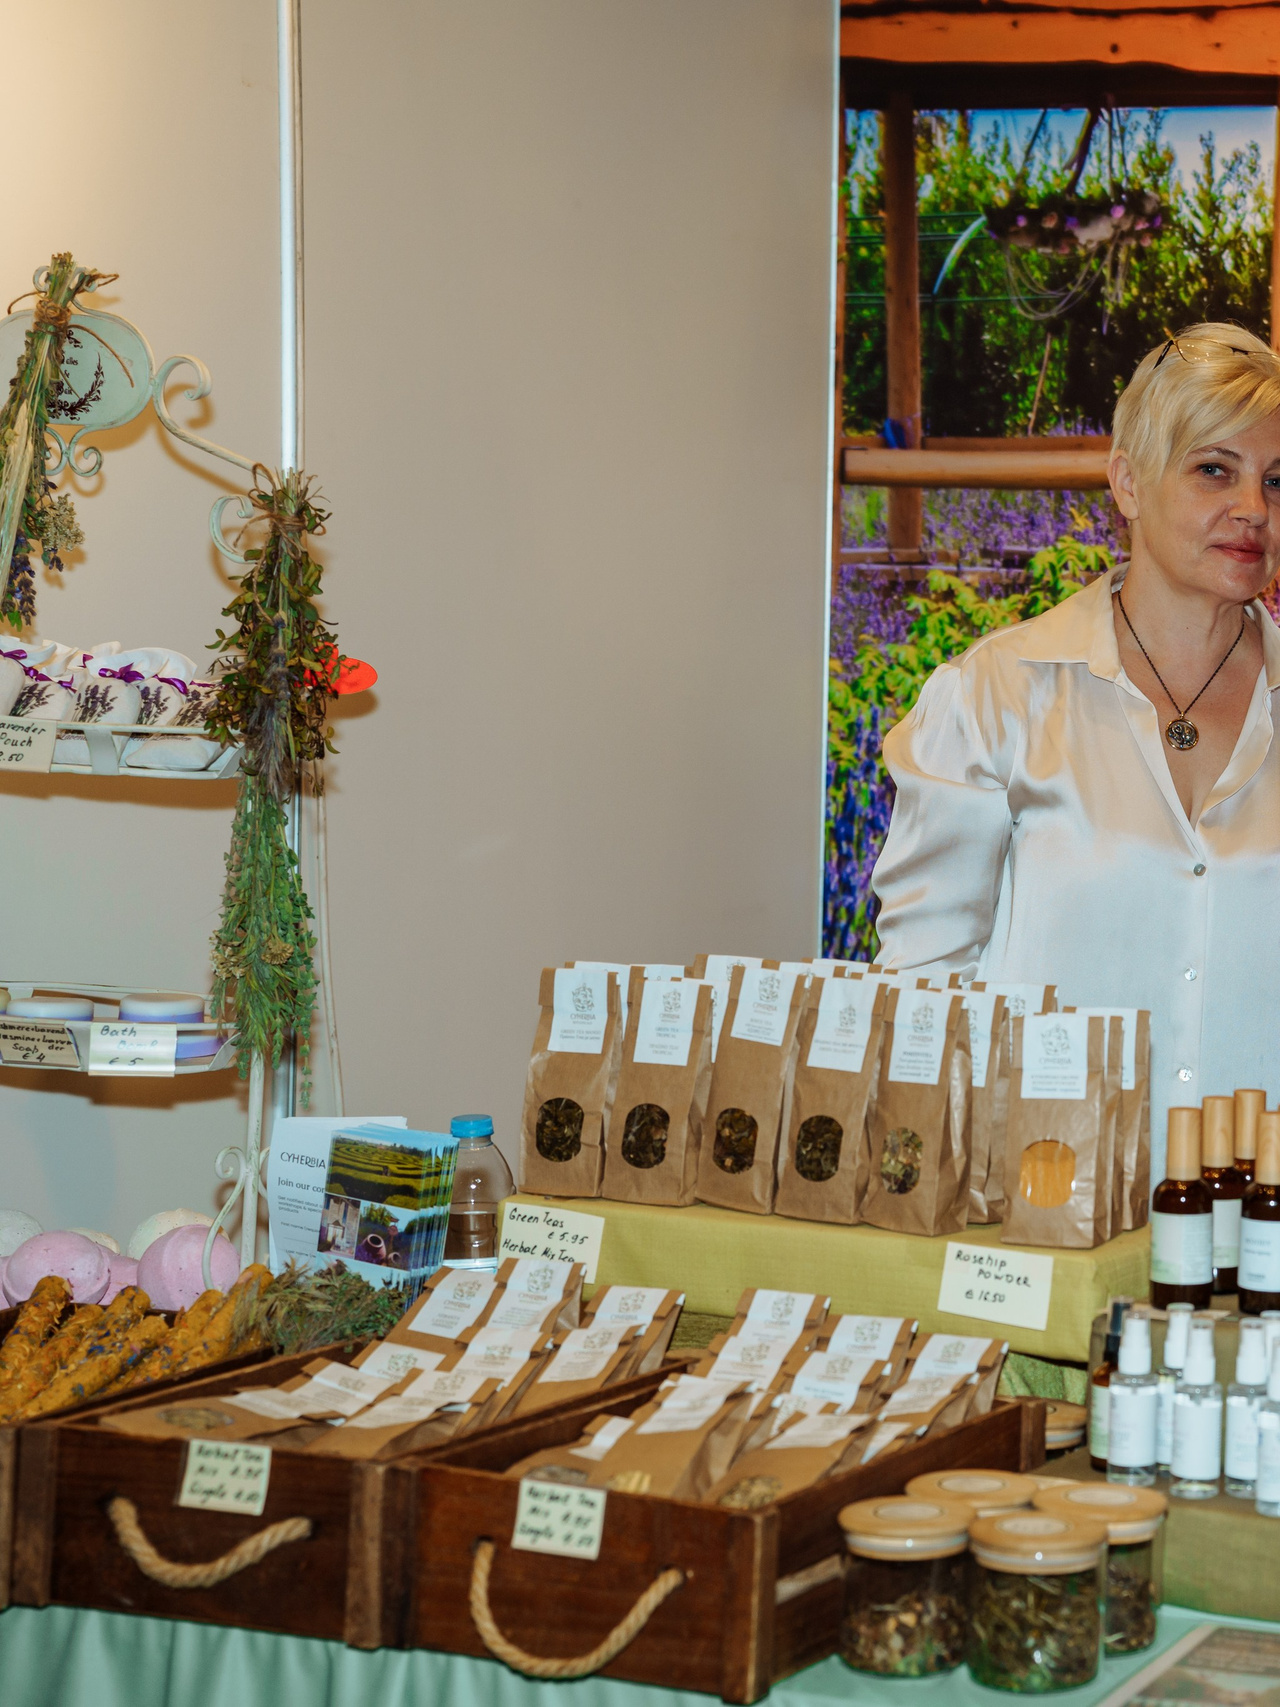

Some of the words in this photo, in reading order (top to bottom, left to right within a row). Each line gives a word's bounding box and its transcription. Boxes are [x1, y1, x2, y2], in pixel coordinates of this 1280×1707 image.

[100, 1025, 137, 1037] Bath
[128, 1056, 145, 1067] 5
[280, 1151, 326, 1169] CYHERBIA
[277, 1176, 294, 1188] Join
[295, 1182, 310, 1191] our
[509, 1207, 539, 1223] Green
[542, 1211, 564, 1228] Teas
[559, 1231, 589, 1245] 5.95
[502, 1238, 537, 1255] Herbal
[540, 1246, 555, 1261] Mix
[557, 1249, 575, 1263] Tea
